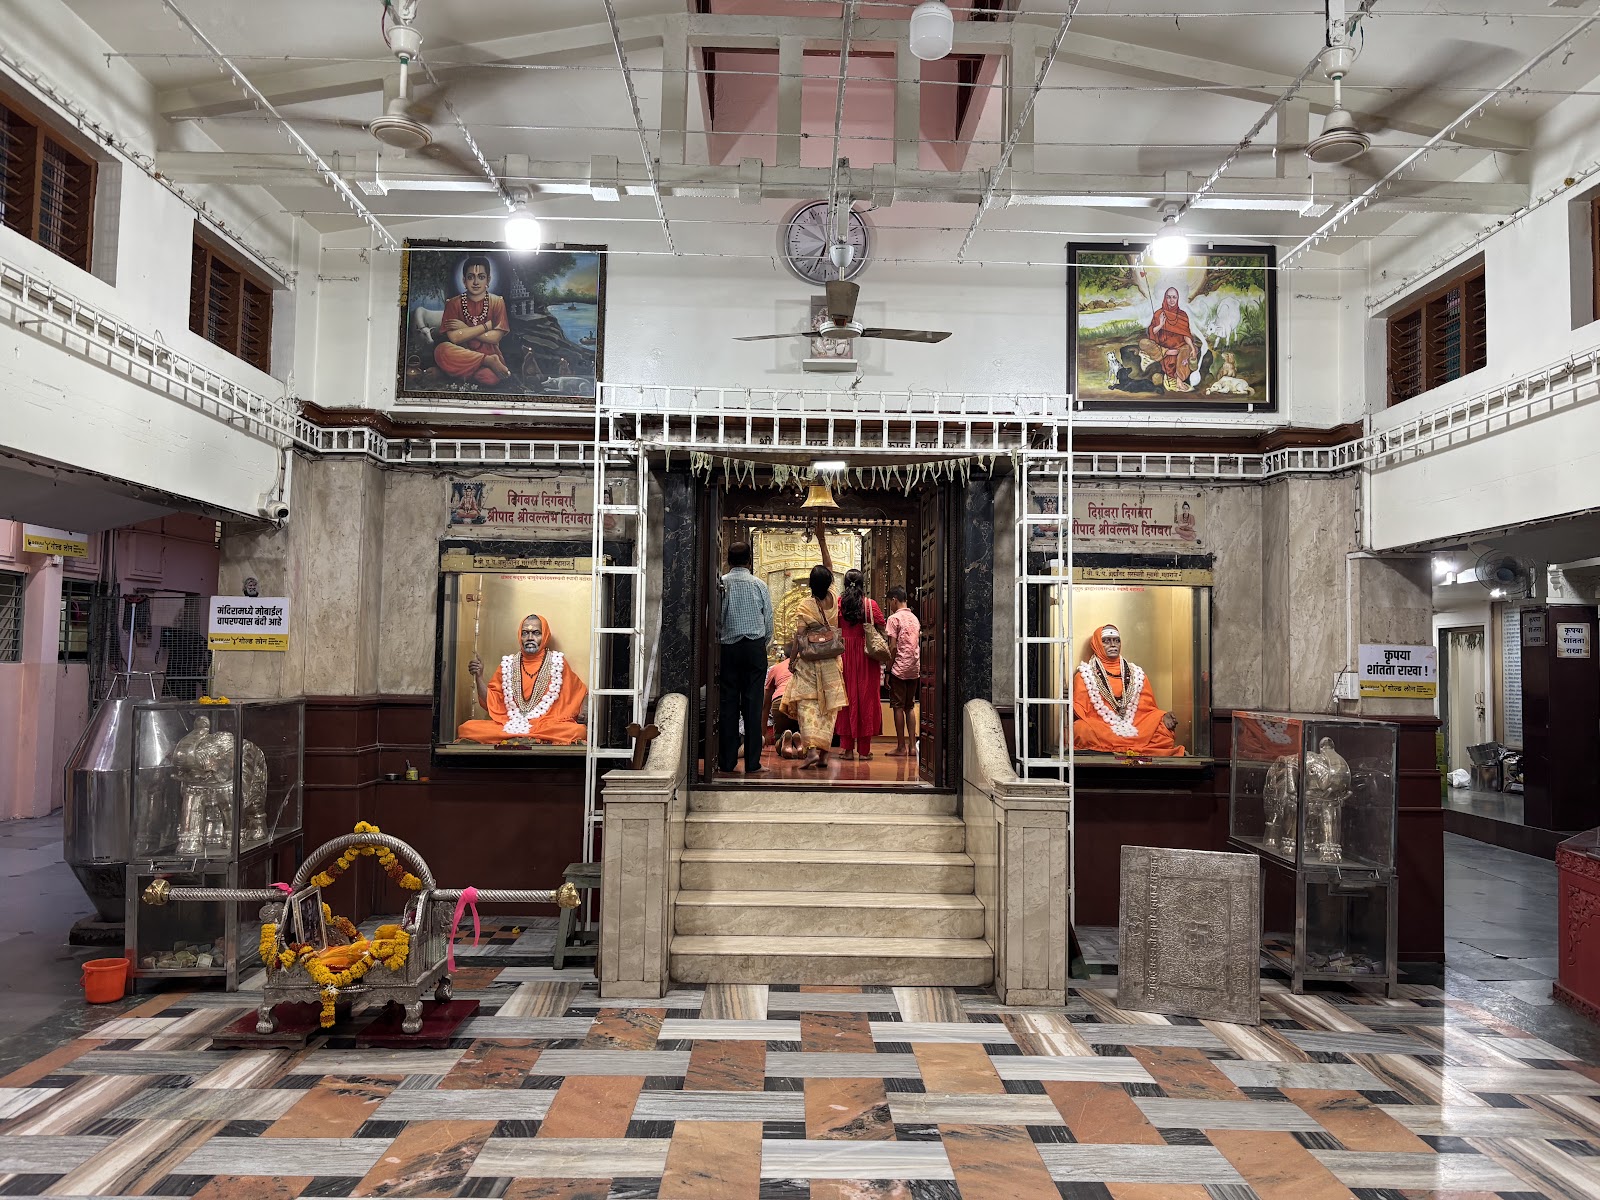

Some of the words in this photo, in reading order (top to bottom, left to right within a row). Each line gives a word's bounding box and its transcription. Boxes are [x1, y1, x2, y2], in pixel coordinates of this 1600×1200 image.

[507, 489, 539, 507] दिगंबरा
[487, 506, 515, 524] श्रीपाद
[517, 508, 558, 525] श्रीवल्लभ
[561, 508, 594, 525] दिगंबरा
[1088, 501, 1119, 519] दिगंबरा
[1121, 502, 1153, 519] दिगंबरा
[1098, 520, 1138, 536] श्रीवल्लभ
[1141, 520, 1173, 538] दिगंबरा
[217, 605, 254, 616] मंदिरामध्ये
[255, 606, 283, 616] मोबाईल
[217, 617, 253, 626] वापरण्यास
[254, 616, 267, 626] बंदी
[268, 616, 282, 626] आहे
[1564, 627, 1584, 636] कृपया
[255, 637, 268, 645] लोन
[1563, 636, 1585, 644] शांतता
[1383, 650, 1411, 664] कृपया
[1367, 662, 1396, 676] शांतता
[1397, 666, 1422, 676] राखा
